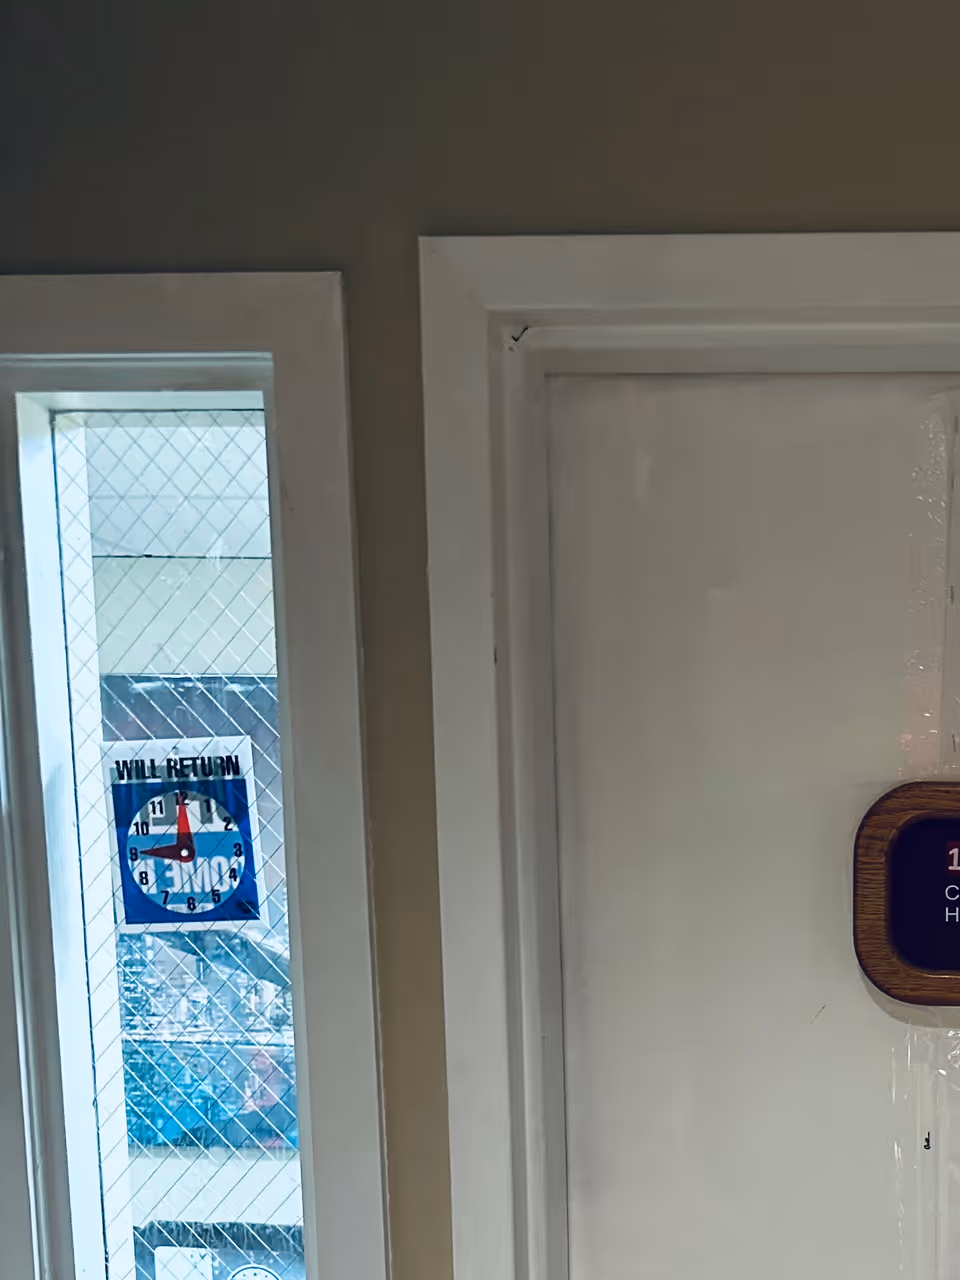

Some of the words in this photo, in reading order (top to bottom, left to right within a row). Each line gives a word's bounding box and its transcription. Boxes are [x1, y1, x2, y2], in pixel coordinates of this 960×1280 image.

[115, 759, 161, 780] WILL
[167, 755, 240, 778] RETURN
[150, 800, 164, 815] 11
[204, 799, 211, 813] 1
[134, 821, 149, 836] 10
[224, 816, 232, 830] 2
[234, 843, 242, 857] 3
[140, 871, 149, 885] 8
[229, 868, 237, 881] 4
[161, 891, 169, 905] 7
[187, 897, 195, 911] 6
[213, 890, 221, 904] 5
